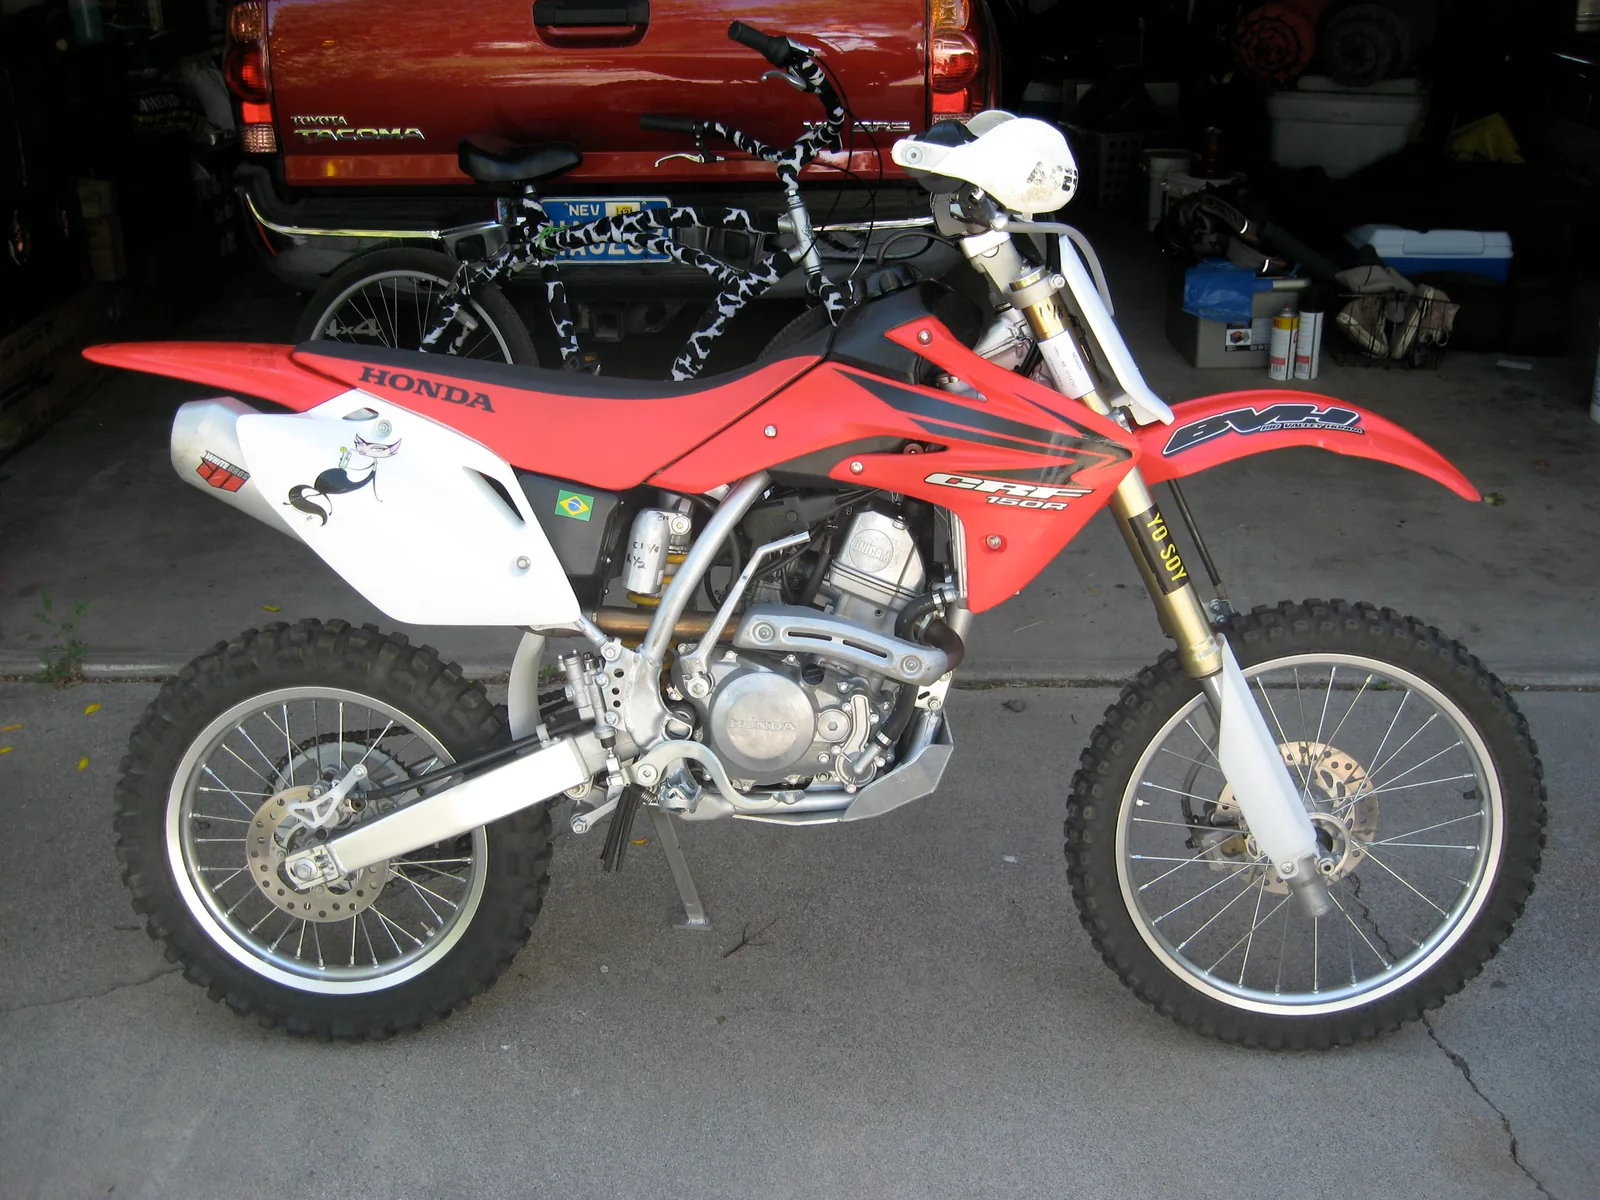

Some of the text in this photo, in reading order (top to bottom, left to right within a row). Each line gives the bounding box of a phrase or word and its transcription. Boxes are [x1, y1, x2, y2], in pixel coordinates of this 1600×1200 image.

[290, 115, 348, 126] TOYOTA
[293, 127, 426, 144] TACOMA
[568, 204, 600, 217] NEV
[358, 366, 496, 413] HONDA
[924, 472, 1096, 499] CRF
[985, 495, 1069, 511] 150R
[1146, 511, 1188, 582] YO SOY
[730, 719, 796, 731] HONDA
